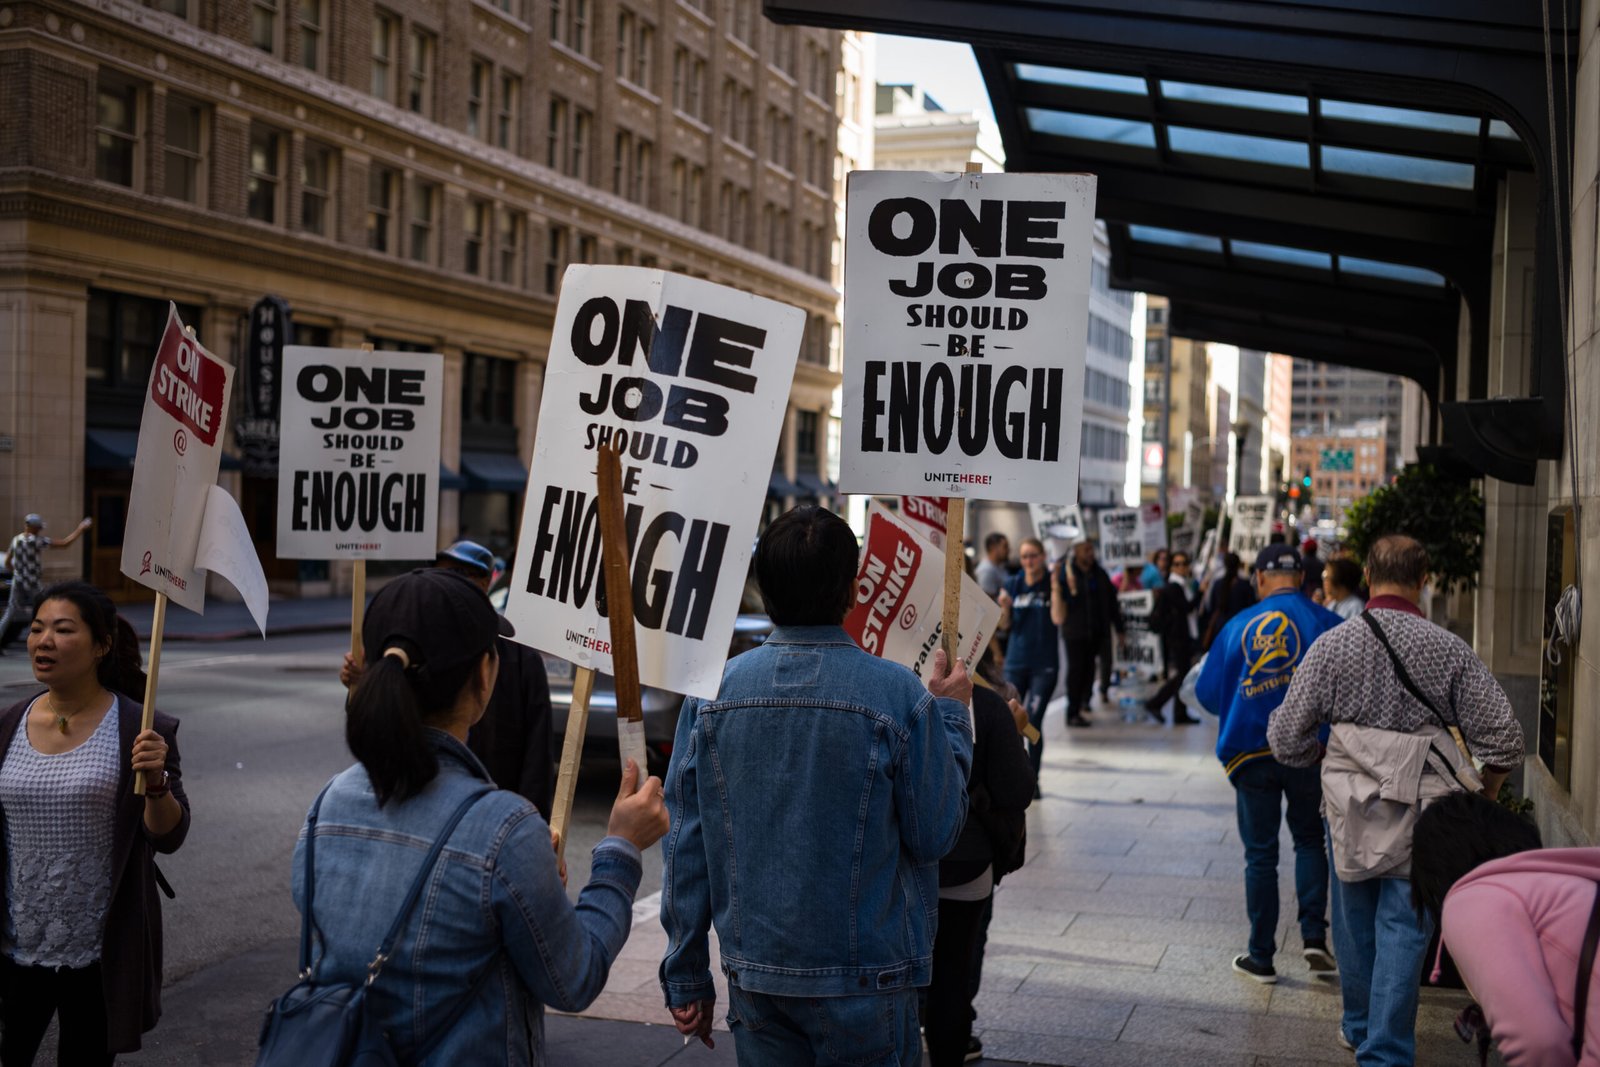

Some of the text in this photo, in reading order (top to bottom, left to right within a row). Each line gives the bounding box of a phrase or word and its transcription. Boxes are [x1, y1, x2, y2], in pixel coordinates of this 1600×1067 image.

[868, 197, 1066, 259] ONE
[889, 262, 1048, 300] JOB
[907, 304, 1028, 330] SHOULD
[176, 342, 200, 383] ON
[571, 296, 768, 394] ONE
[947, 334, 985, 358] BE
[157, 363, 214, 434] STRIKE
[297, 365, 425, 406] ONE
[311, 407, 416, 432] JOB
[579, 373, 729, 437] JOB
[861, 361, 1063, 462] ENOUGH
[173, 429, 188, 457] @
[323, 434, 404, 452] SHOULD
[584, 423, 699, 469] SHOULD
[350, 453, 376, 469] BE
[924, 472, 992, 485] UNITEHERE!
[621, 466, 643, 496] E
[291, 471, 426, 533] ENOUGH
[907, 496, 947, 529] STRIK
[335, 542, 382, 552] UNITEHERE!
[154, 563, 187, 591] UNITEHERE!
[858, 553, 887, 604] ON
[861, 540, 915, 656] STRIKE
[900, 604, 918, 630] @
[566, 629, 613, 656] UNITEHER
[913, 620, 943, 678] Palac
[965, 631, 984, 671] EHERE!
[1249, 610, 1290, 676] 2
[1252, 635, 1289, 651] LOCAL
[1246, 675, 1291, 696] UNITEHER
